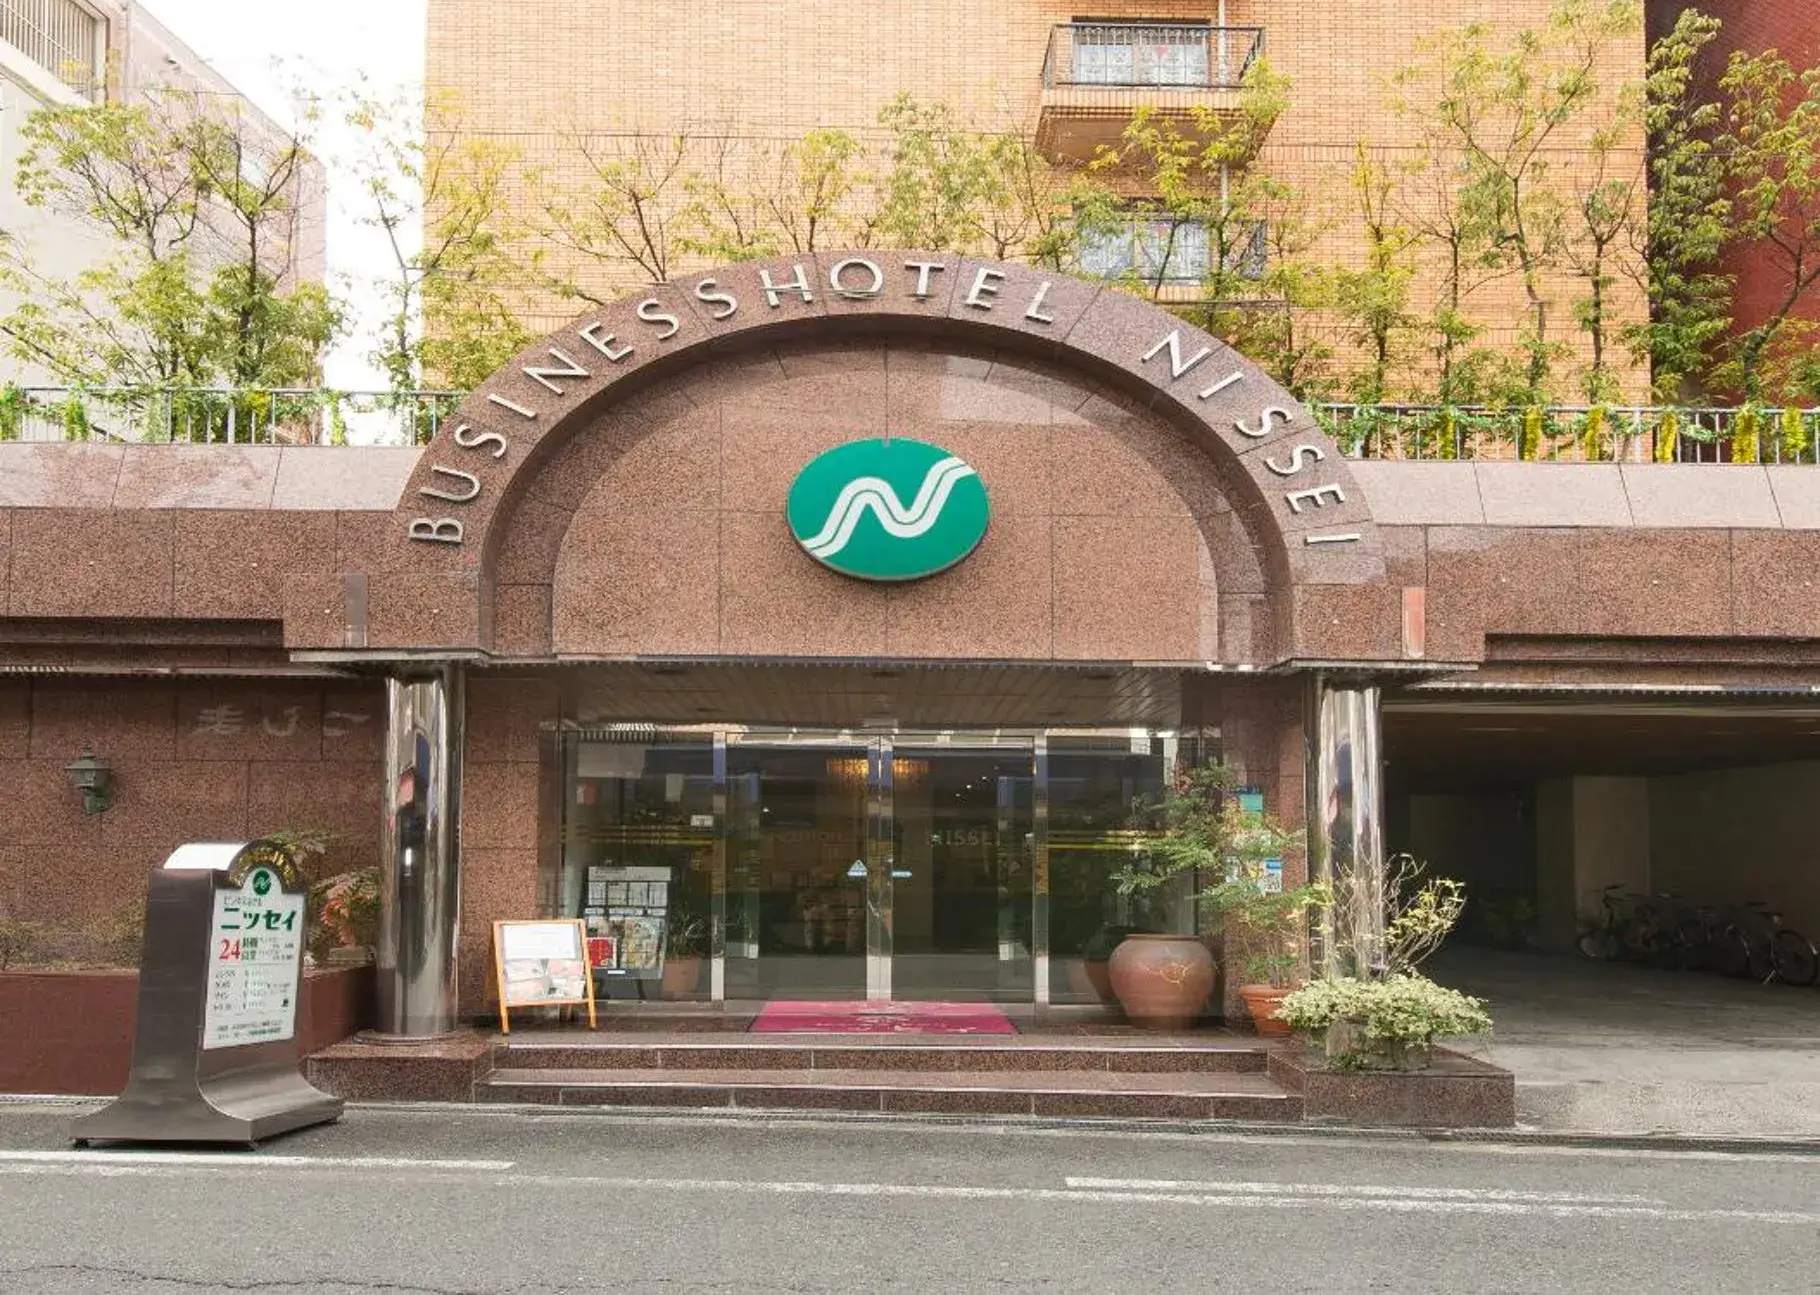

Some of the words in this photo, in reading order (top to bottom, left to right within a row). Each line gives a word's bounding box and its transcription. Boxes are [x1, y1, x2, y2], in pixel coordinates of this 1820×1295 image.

[408, 277, 738, 544] BUSINESS
[759, 256, 1053, 324] HOTEL
[1141, 329, 1361, 544] NISSEI
[220, 907, 297, 931] ニッセイ
[219, 938, 240, 960] 24
